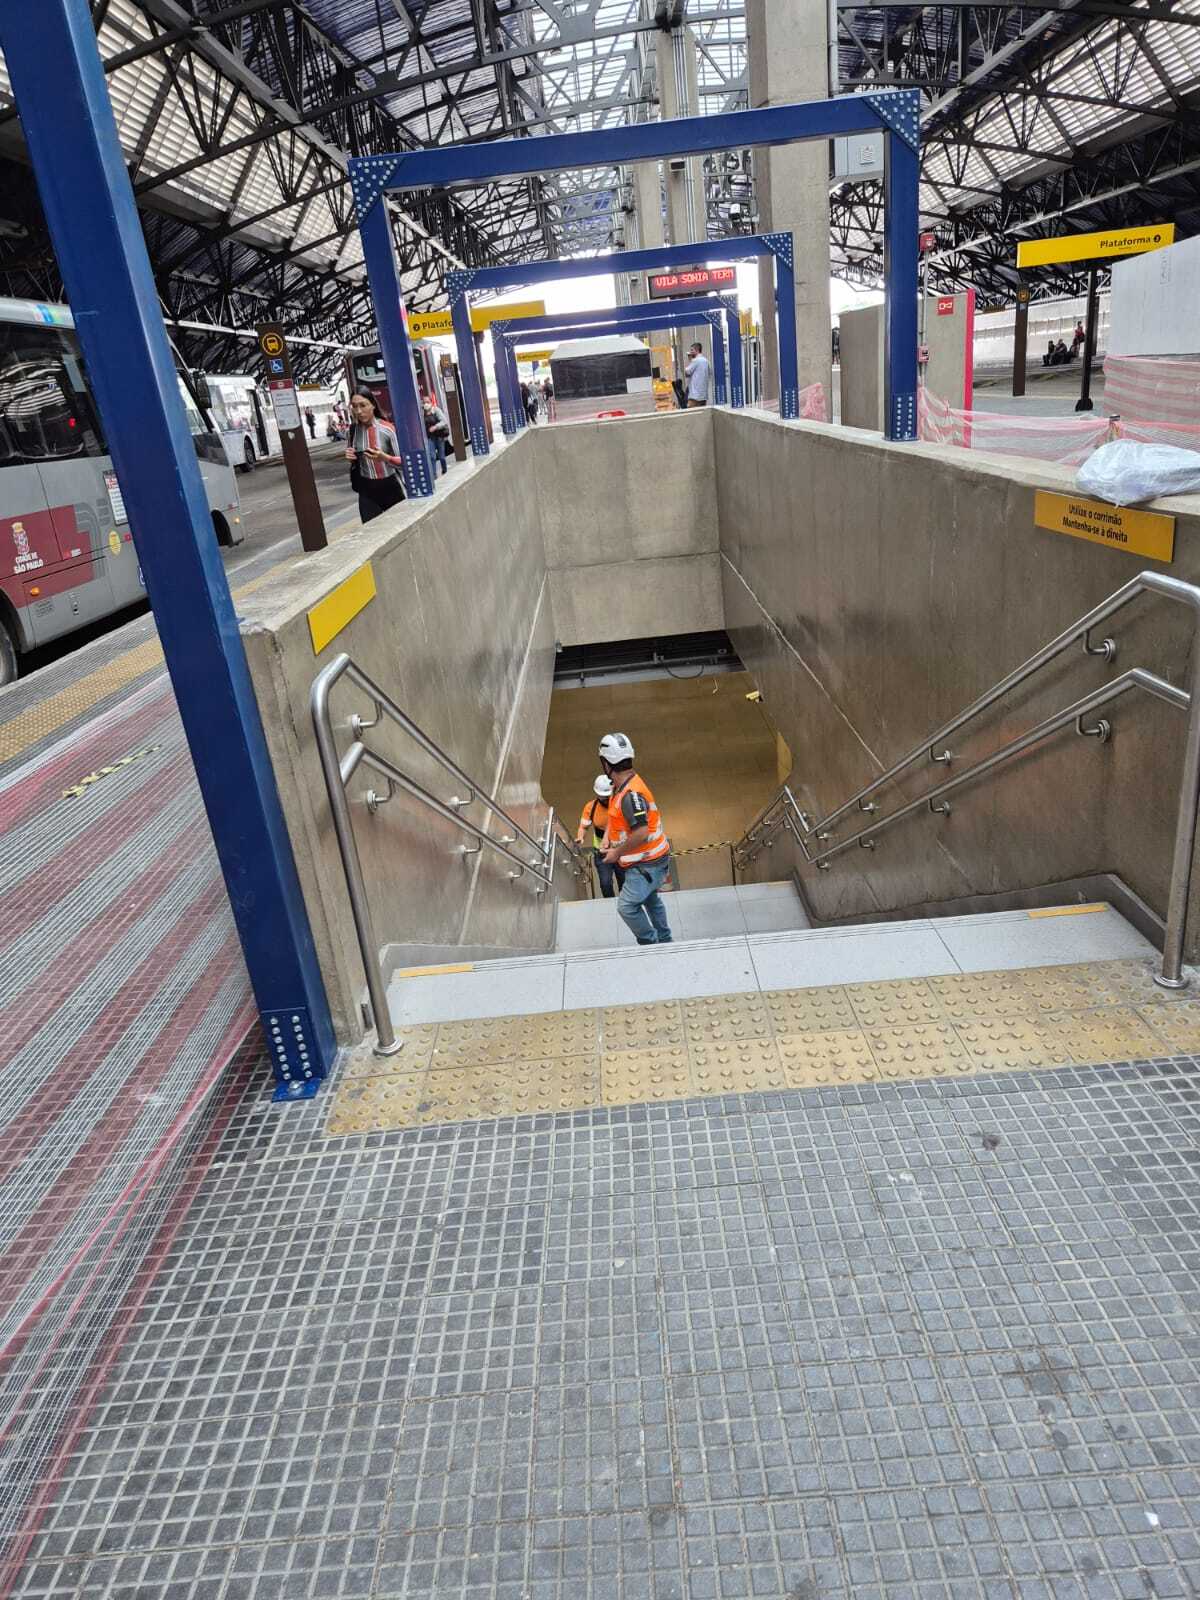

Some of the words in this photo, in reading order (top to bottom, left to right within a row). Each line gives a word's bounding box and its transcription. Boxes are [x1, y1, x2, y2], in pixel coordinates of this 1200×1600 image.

[1100, 237, 1151, 249] Plataforma
[656, 276, 678, 287] VILA
[422, 319, 454, 330] Platafo
[1093, 511, 1122, 526] corrimão
[1062, 516, 1100, 535] Mantenha-se
[1106, 527, 1128, 543] direita
